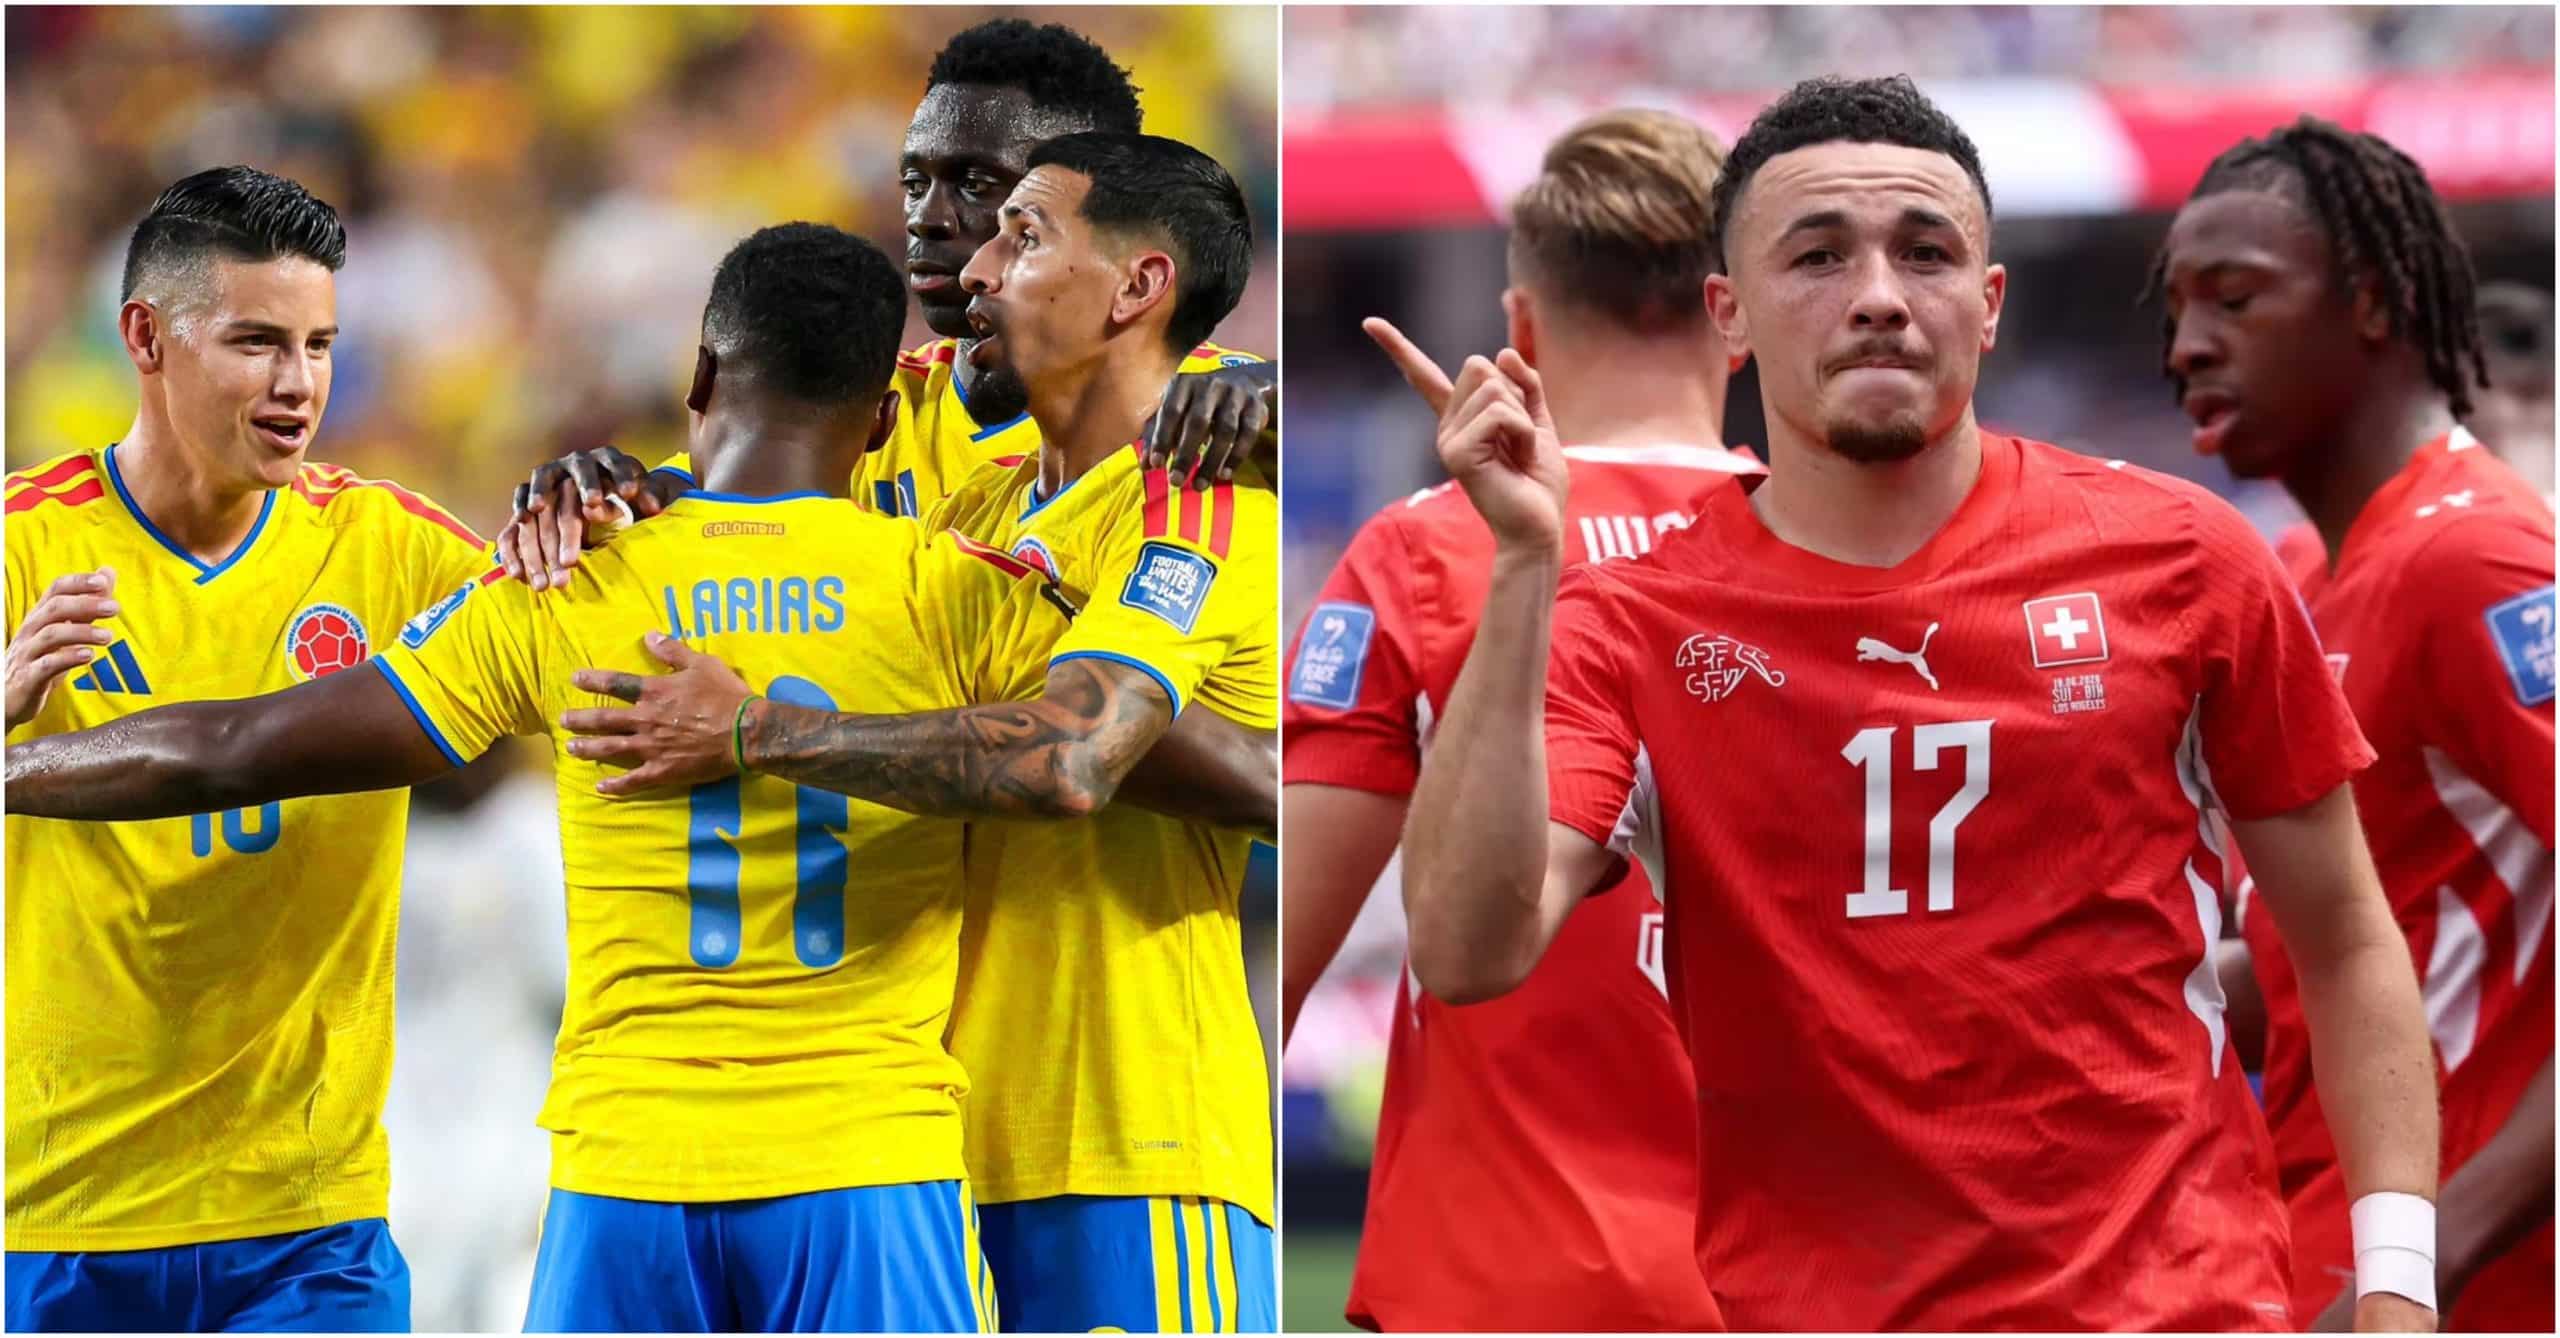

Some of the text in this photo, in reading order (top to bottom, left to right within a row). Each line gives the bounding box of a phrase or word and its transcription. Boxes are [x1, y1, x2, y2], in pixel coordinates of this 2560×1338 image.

[703, 521, 785, 538] COLOMBIA
[1147, 566, 1197, 595] UNITES
[1152, 555, 1199, 579] FOOTBALL
[664, 576, 845, 640] J.ARIAS
[1840, 719, 1996, 919] 17
